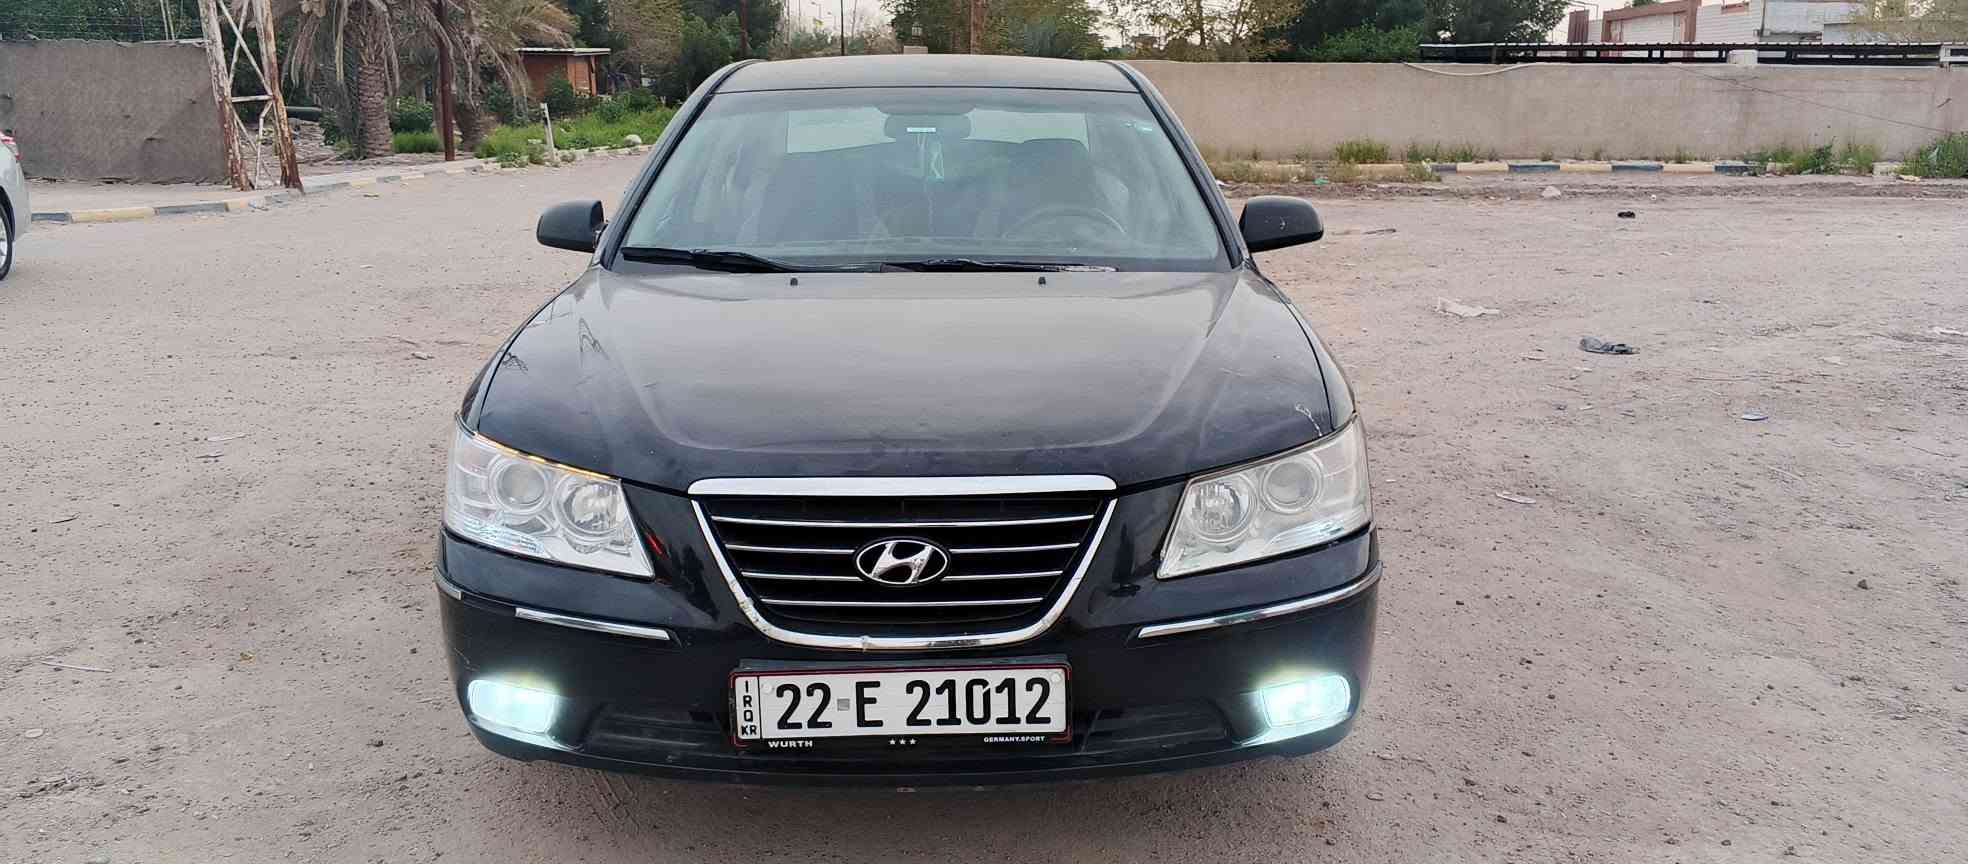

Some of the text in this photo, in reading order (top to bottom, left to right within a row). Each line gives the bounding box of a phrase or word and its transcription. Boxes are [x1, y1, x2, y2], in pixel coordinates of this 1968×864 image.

[776, 677, 1051, 730] 22 E 21012
[741, 725, 757, 736] KR
[768, 740, 813, 748] WURTH
